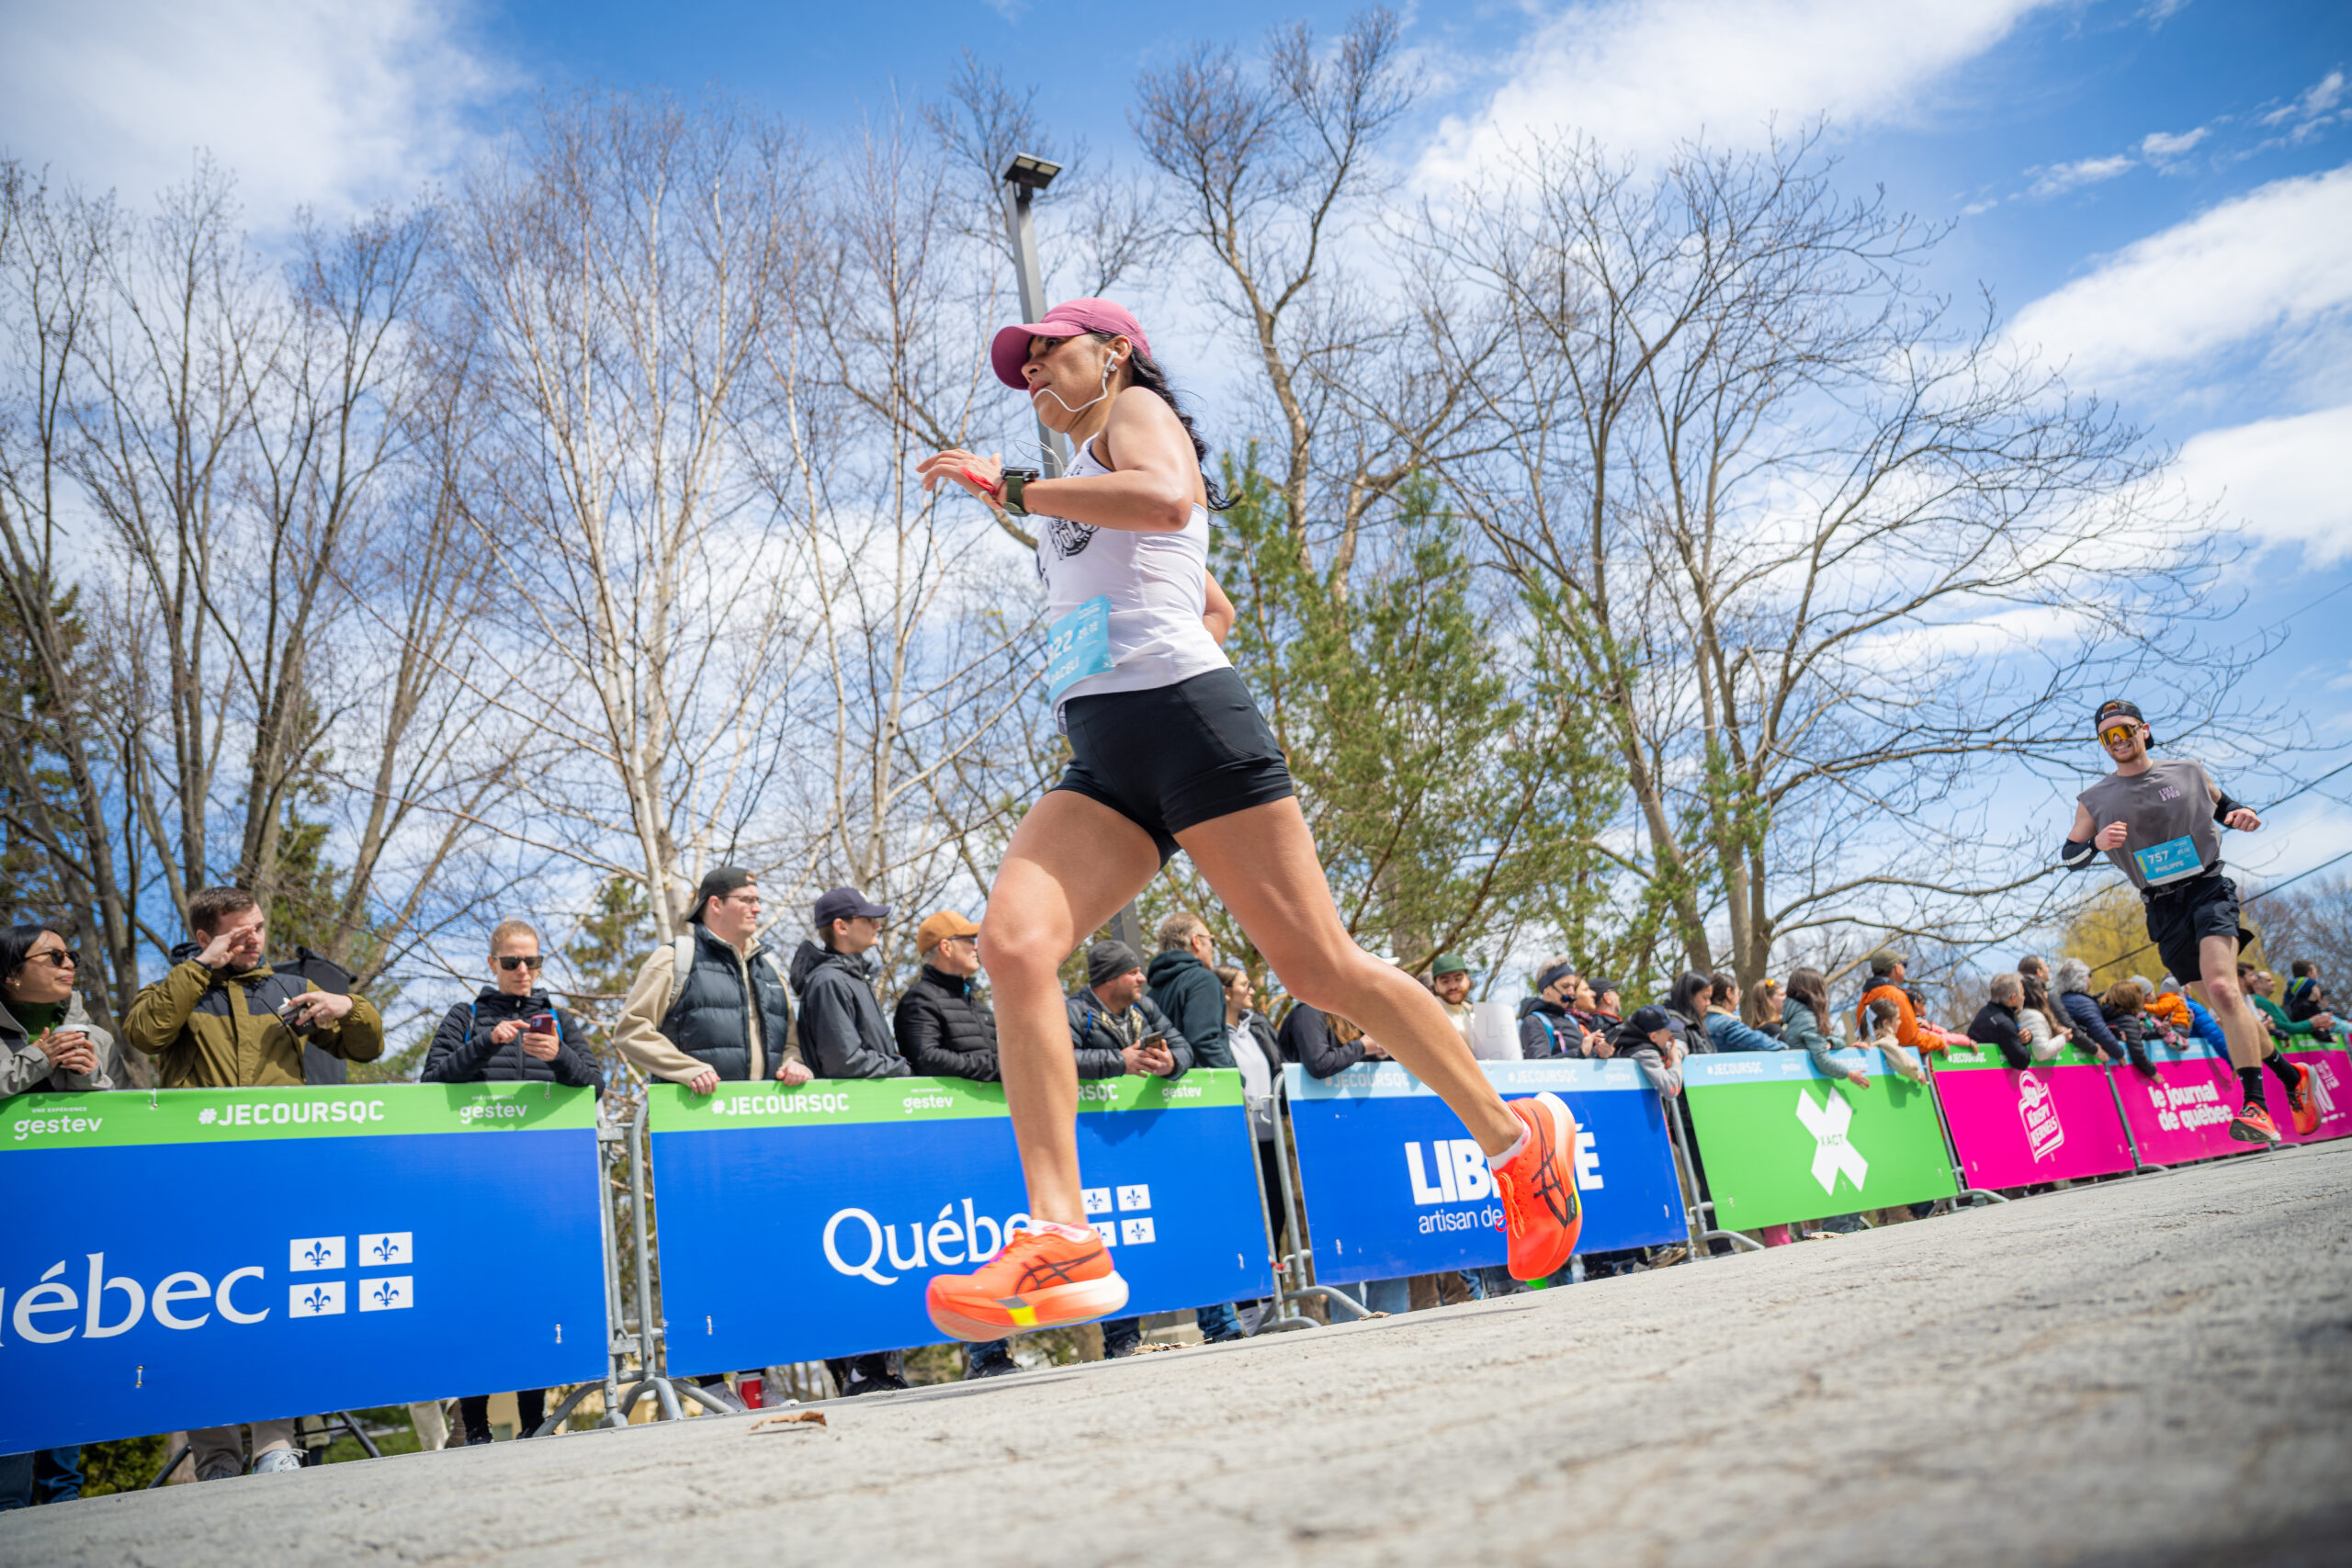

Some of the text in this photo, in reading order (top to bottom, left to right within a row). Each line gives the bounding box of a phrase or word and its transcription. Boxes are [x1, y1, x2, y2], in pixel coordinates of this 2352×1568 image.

[2147, 850, 2169, 864] 757
[1508, 1068, 1578, 1084] #JECOURSQC
[711, 1093, 850, 1116] #JECOURSQC
[903, 1094, 954, 1113] gestev
[1161, 1085, 1203, 1102] gestev
[2148, 1079, 2220, 1111] le journal
[198, 1100, 385, 1126] #JECOURSQC
[459, 1102, 527, 1124] gestev
[2158, 1102, 2233, 1132] de québec
[14, 1114, 103, 1141] gestev
[1404, 1122, 1604, 1205] LIBÉ
[1419, 1204, 1504, 1234] artisan de
[0, 1251, 271, 1348] ébec
